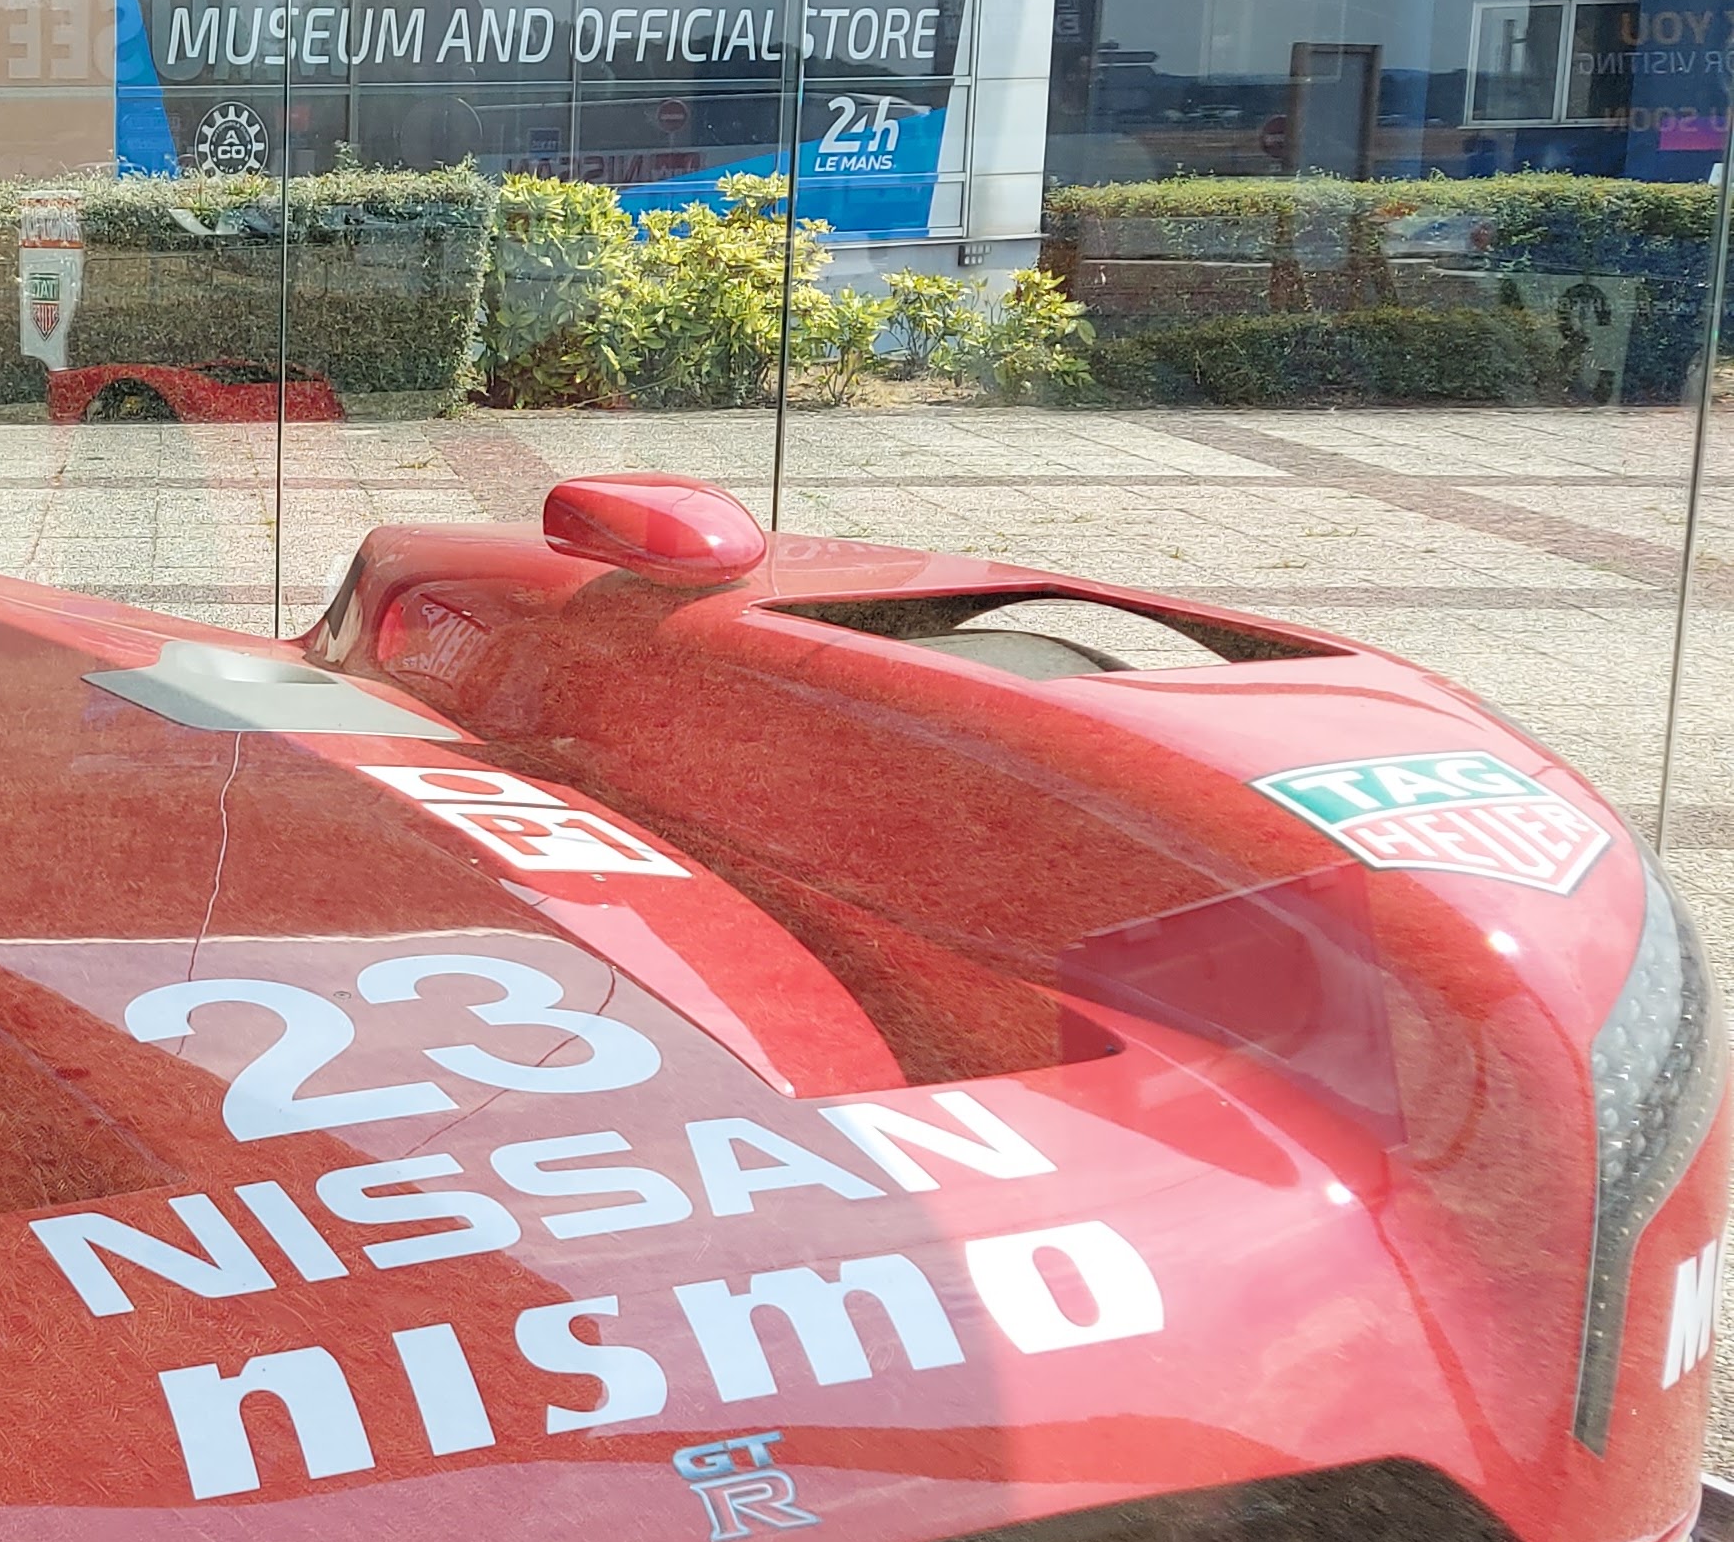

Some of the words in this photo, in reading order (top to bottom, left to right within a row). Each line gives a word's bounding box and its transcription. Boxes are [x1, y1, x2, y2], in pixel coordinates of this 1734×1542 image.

[166, 5, 428, 67] MUSEUM
[436, 5, 554, 65] AND
[570, 5, 782, 65] OFFICIAL
[802, 4, 941, 61] STORE
[814, 156, 838, 172] LE
[840, 154, 886, 172] MANS
[1293, 755, 1524, 816] TAG
[456, 812, 653, 863] P1
[1358, 804, 1584, 885] HEUER
[123, 950, 663, 1142] 23
[28, 1087, 1059, 1318] NISSAN
[157, 1219, 1167, 1501] nismo
[672, 1430, 785, 1481] GT
